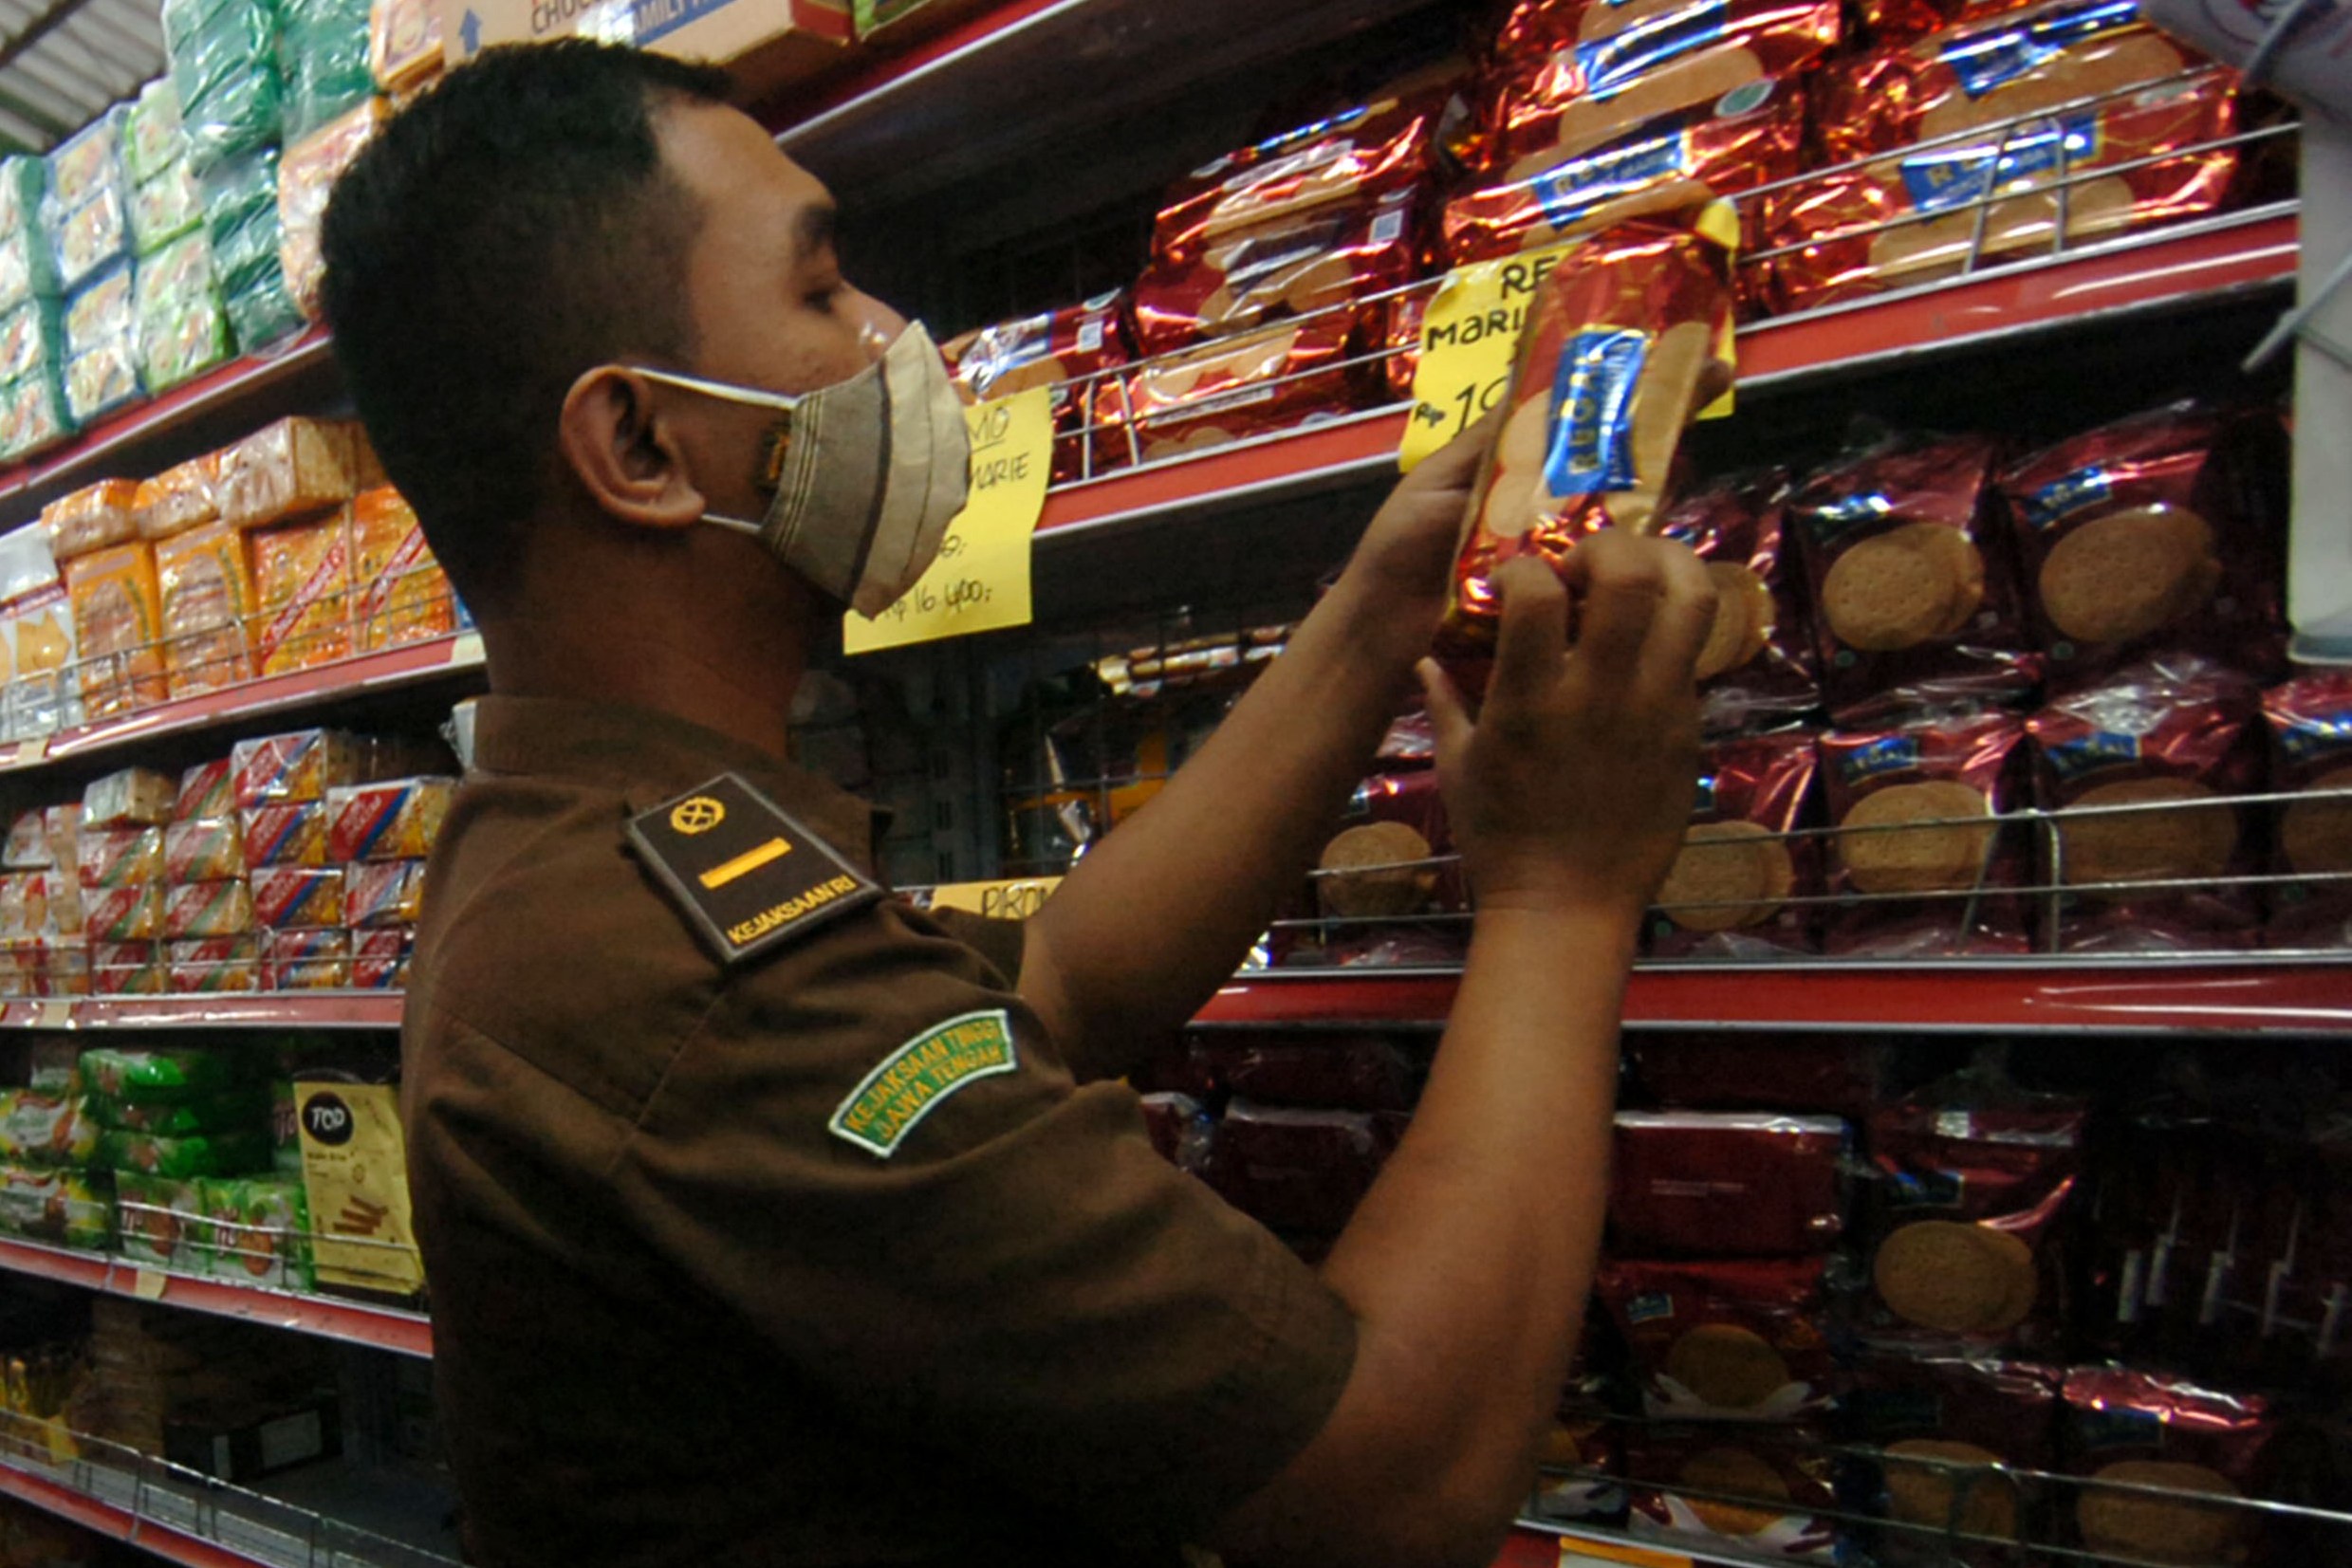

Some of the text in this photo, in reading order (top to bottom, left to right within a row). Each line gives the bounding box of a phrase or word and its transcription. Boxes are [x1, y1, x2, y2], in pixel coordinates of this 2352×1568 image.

[1501, 254, 1558, 300] RE
[727, 874, 858, 945] KEJAKSAAN RI
[844, 1036, 949, 1133] KEJAKSAAN
[877, 1045, 1003, 1139] JAWA TENGAH
